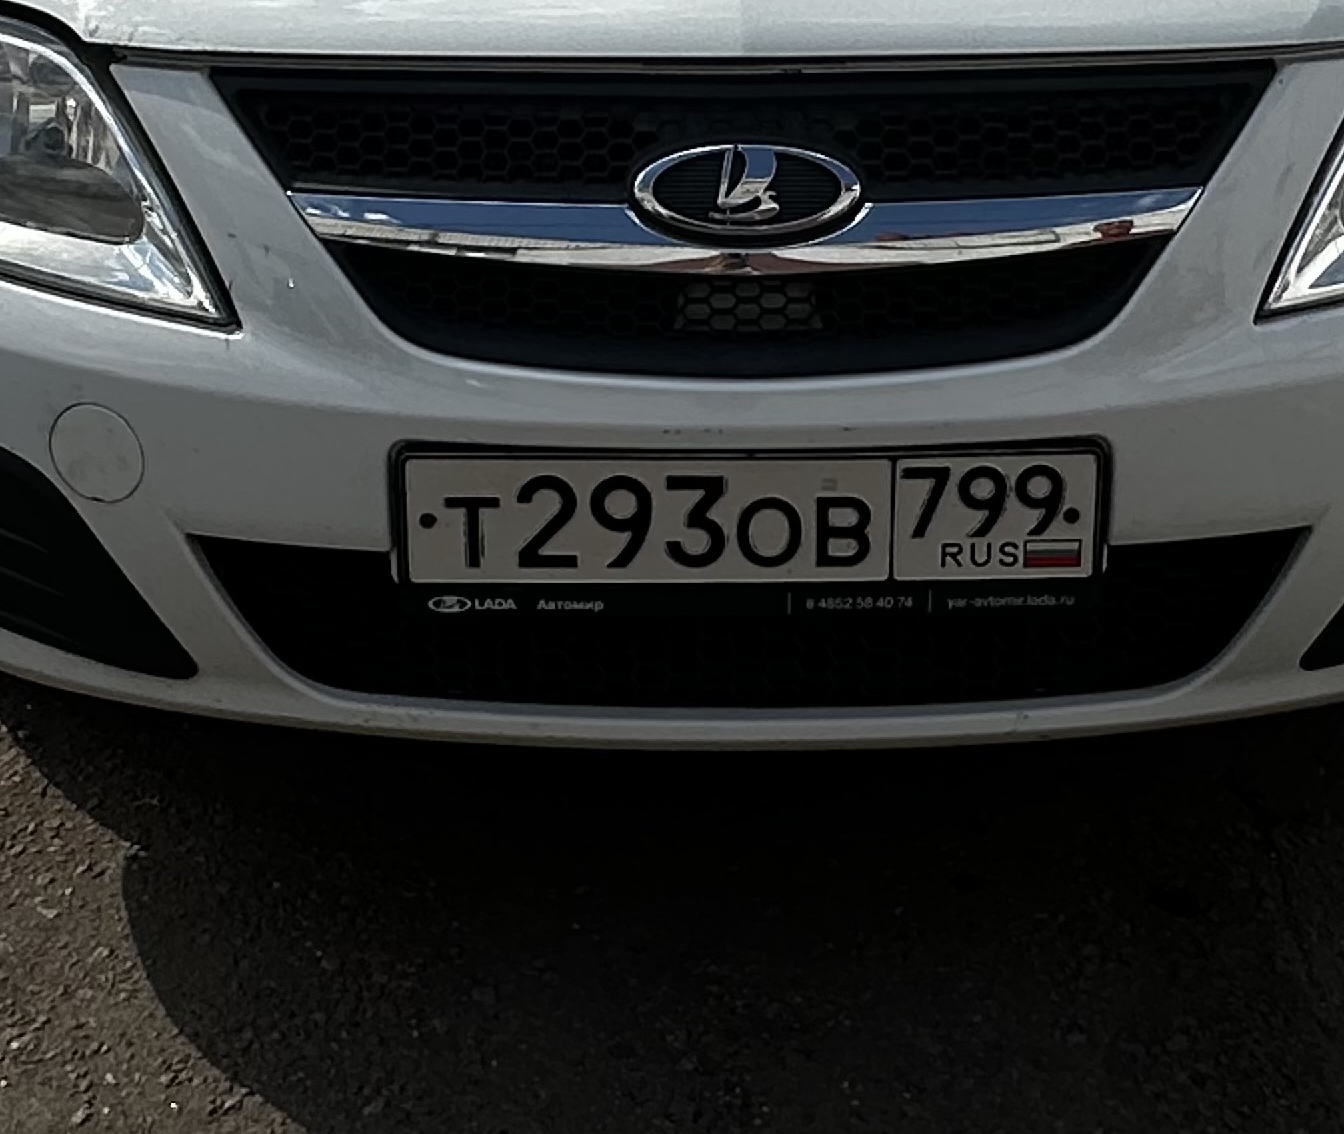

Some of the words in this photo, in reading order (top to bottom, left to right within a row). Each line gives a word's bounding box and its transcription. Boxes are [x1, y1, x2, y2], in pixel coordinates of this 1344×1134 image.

[443, 473, 872, 570] Т293ОВ
[900, 464, 1065, 539] 799
[940, 543, 1020, 569] RUS
[474, 598, 518, 610] LADA
[536, 598, 605, 614] Автомир
